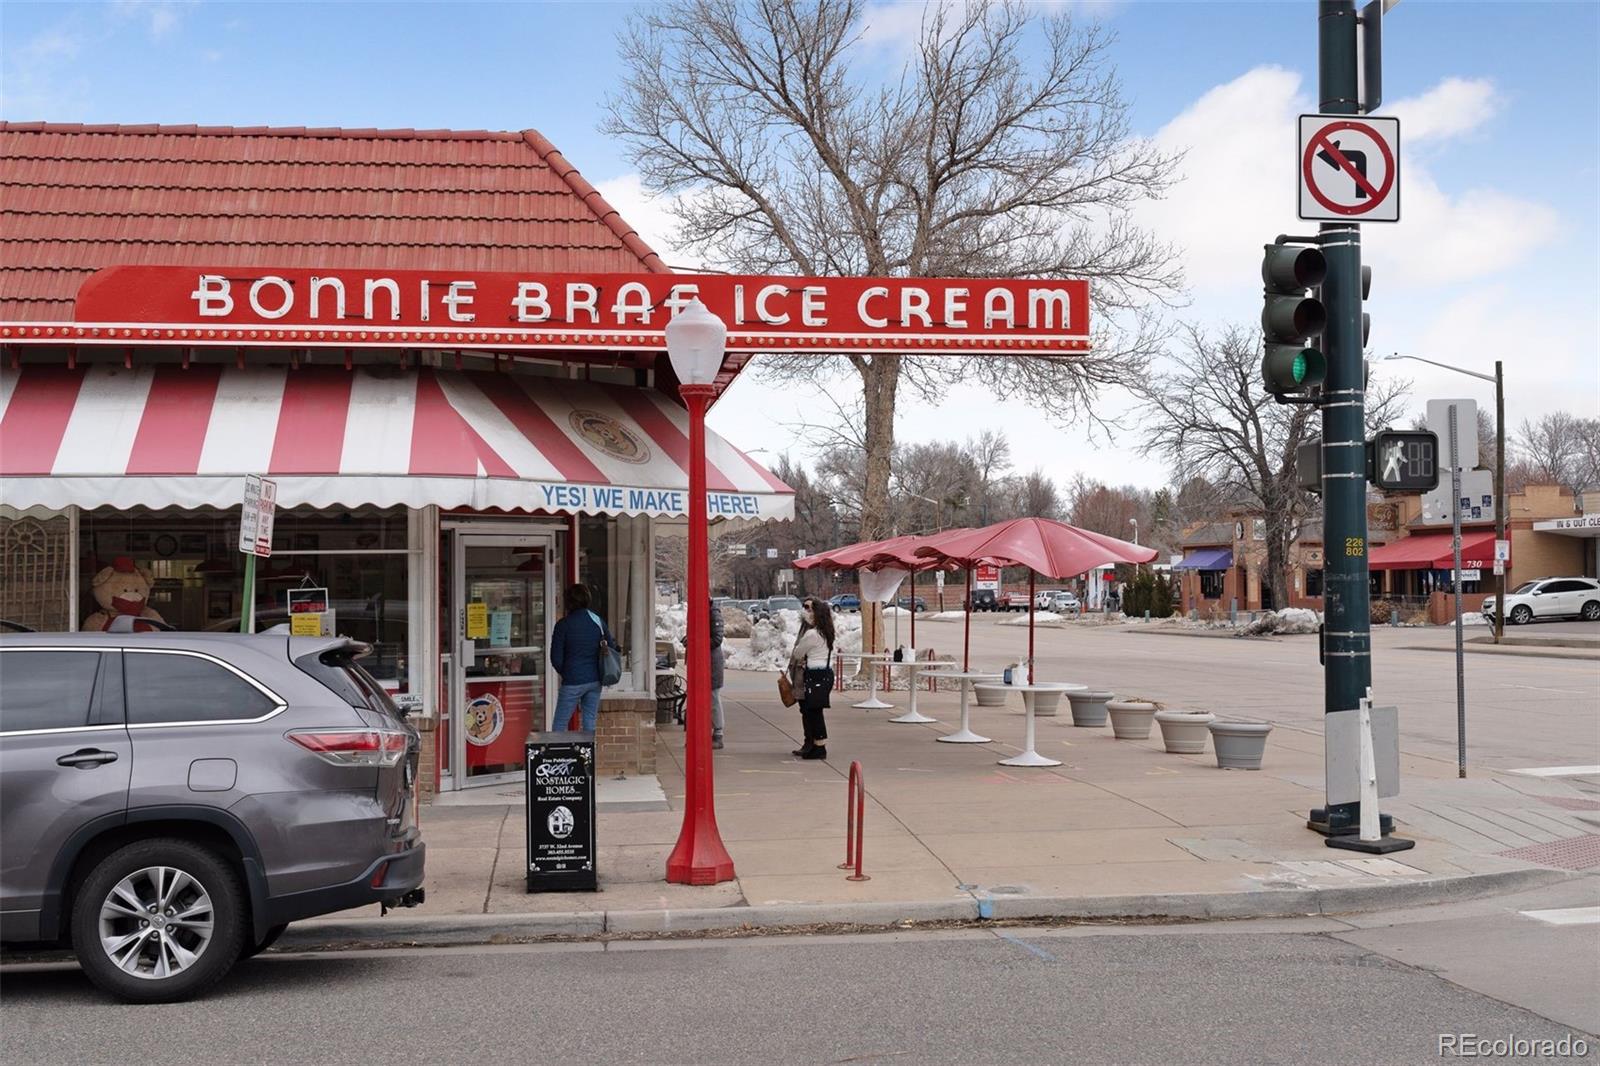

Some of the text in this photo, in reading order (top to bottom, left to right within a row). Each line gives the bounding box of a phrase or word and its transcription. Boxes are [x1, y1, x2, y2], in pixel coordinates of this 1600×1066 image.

[191, 275, 477, 322] BONNIE
[735, 284, 828, 327] ICE
[857, 286, 1071, 329] CREAM
[541, 485, 587, 507] YES!
[593, 488, 624, 509] WE
[629, 490, 682, 512] MAKE
[709, 494, 760, 515] HERE!
[1573, 519, 1586, 527] OUT
[1346, 538, 1363, 547] 226
[1346, 547, 1363, 556] 802
[1466, 560, 1483, 568] 730
[291, 602, 325, 612] OPEN
[536, 776, 585, 785] NOSTALGIC
[546, 786, 575, 795] HOMES
